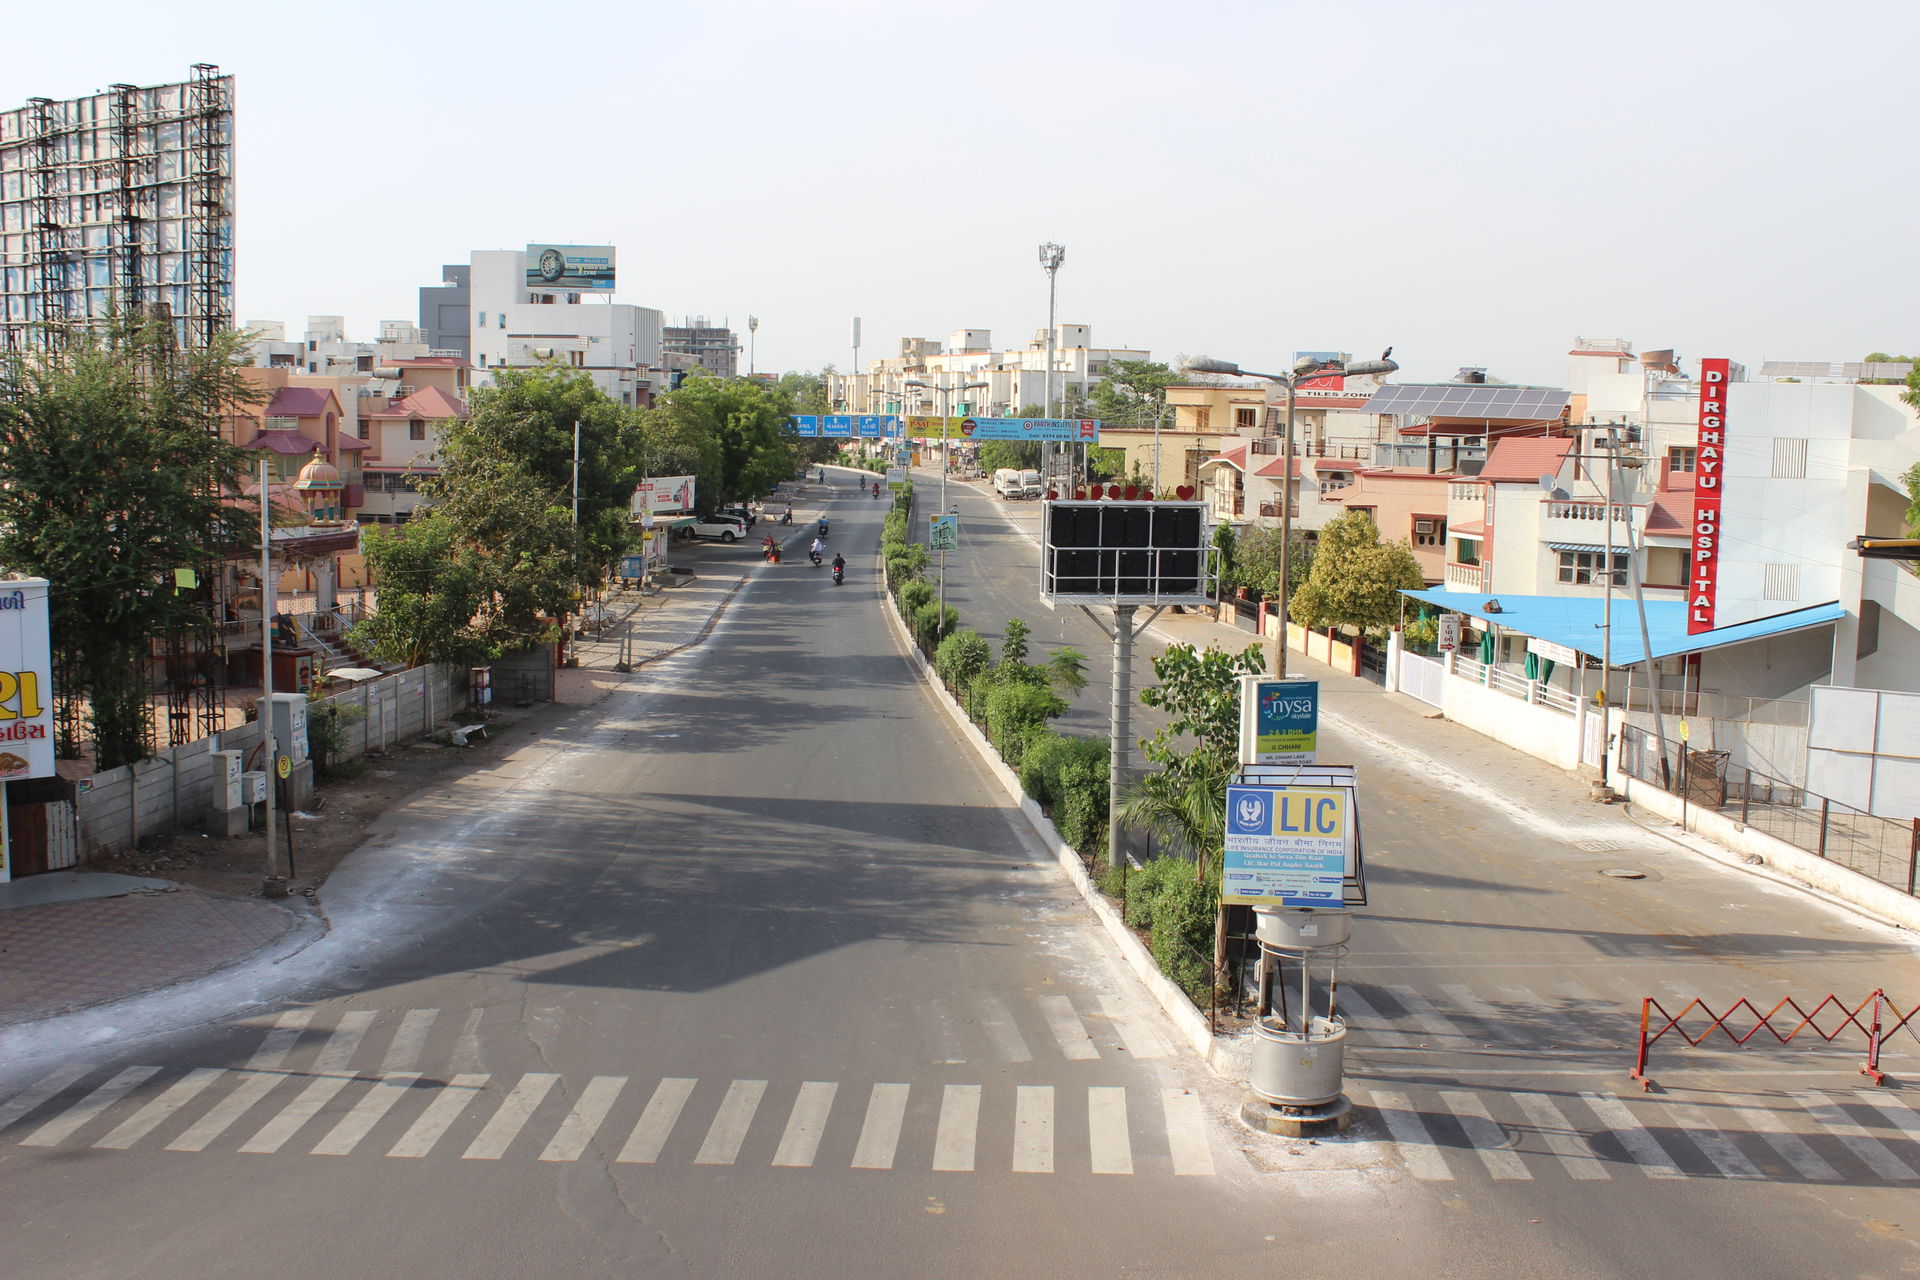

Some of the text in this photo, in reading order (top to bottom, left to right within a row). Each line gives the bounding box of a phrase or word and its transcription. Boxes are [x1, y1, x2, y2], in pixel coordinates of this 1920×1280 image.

[1700, 370, 1722, 488] DIRGHAYU
[1693, 510, 1715, 622] HOSPITAL
[1272, 700, 1312, 718] nysa
[1281, 797, 1336, 833] LIC
[1265, 838, 1289, 846] जीवन
[1295, 838, 1313, 847] बीमा
[1318, 839, 1342, 848] निगम
